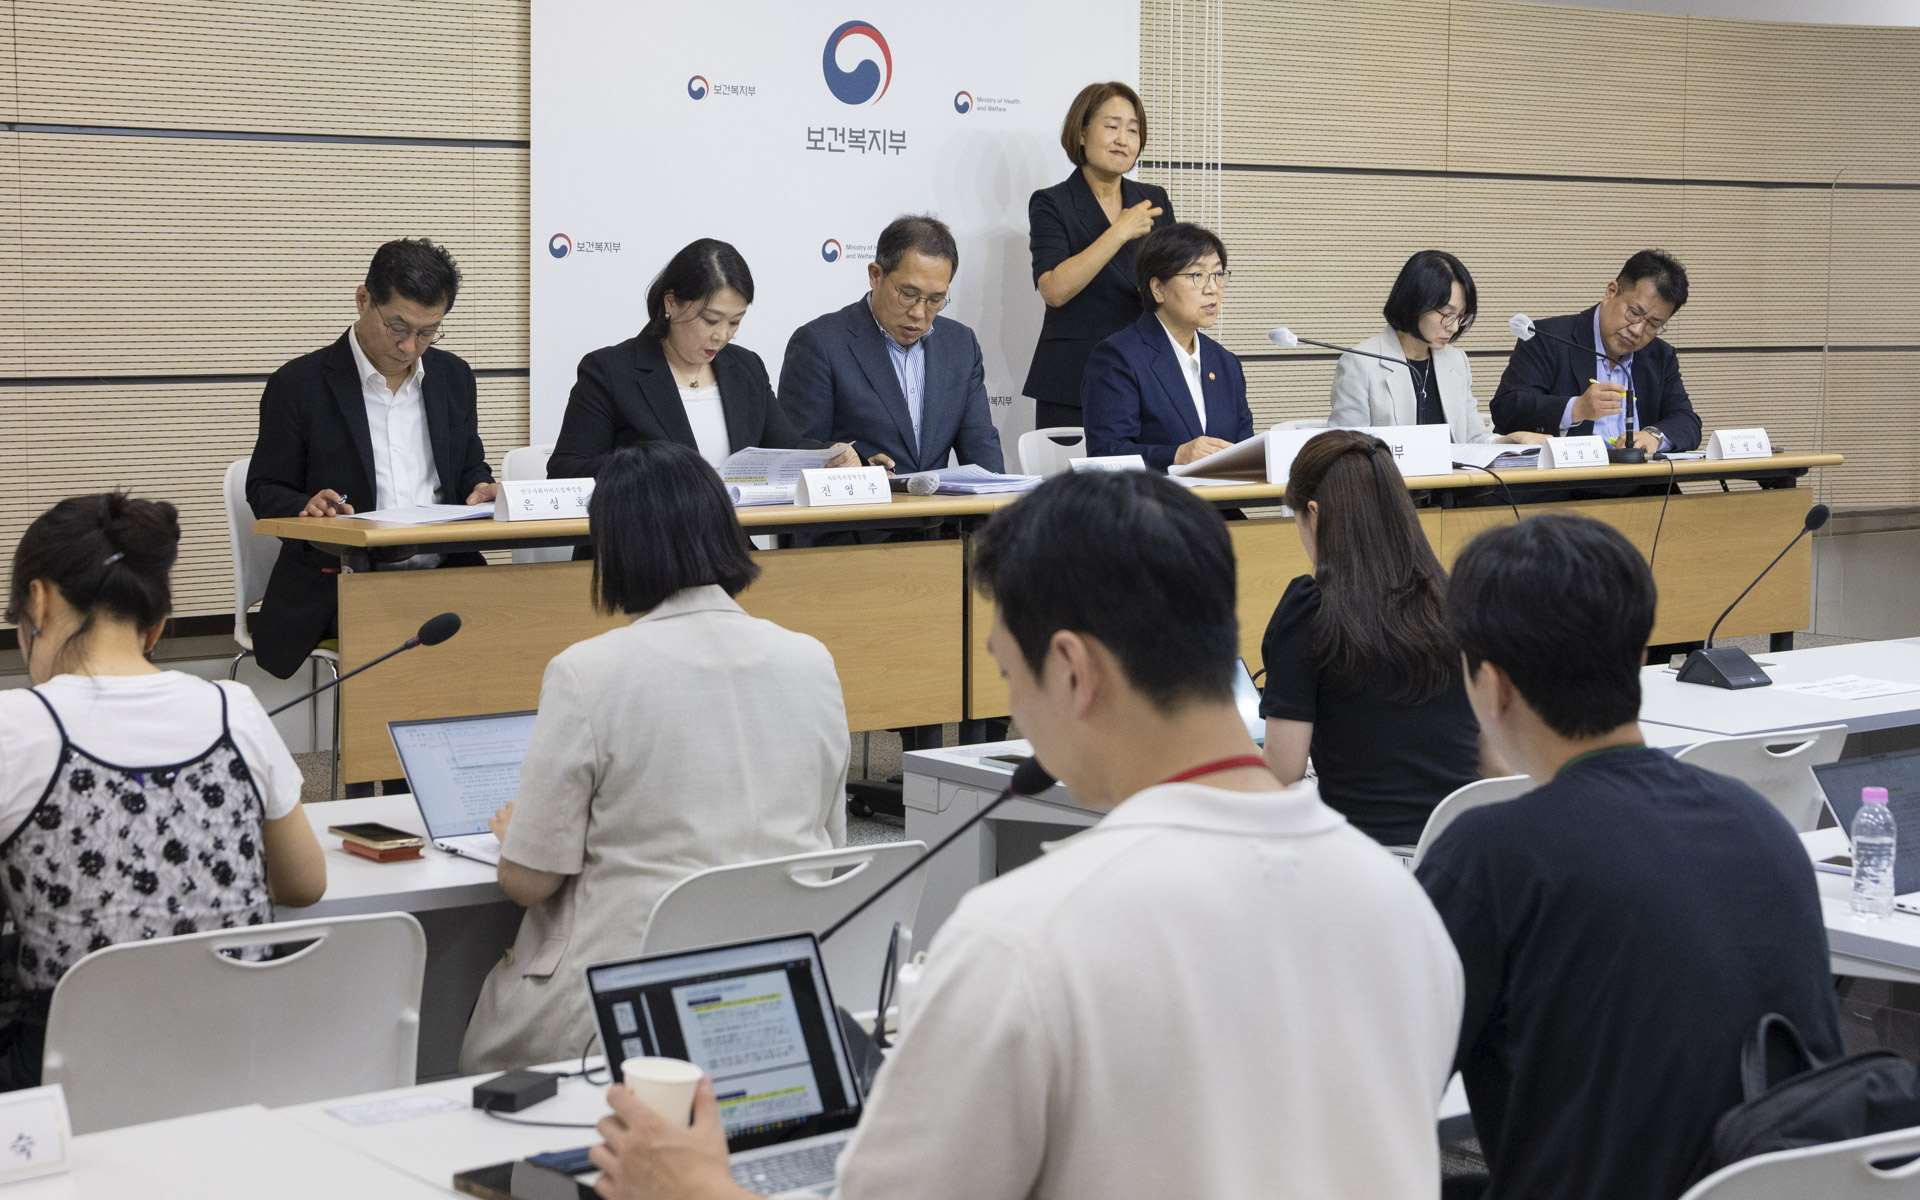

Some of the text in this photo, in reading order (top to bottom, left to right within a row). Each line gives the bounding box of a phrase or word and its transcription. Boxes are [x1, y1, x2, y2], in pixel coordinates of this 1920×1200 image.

[713, 84, 756, 96] 보건복지부
[976, 96, 996, 104] Ministry
[806, 126, 907, 155] 보건복지부
[577, 241, 621, 253] 보건복지부
[987, 395, 1012, 406] 복지부
